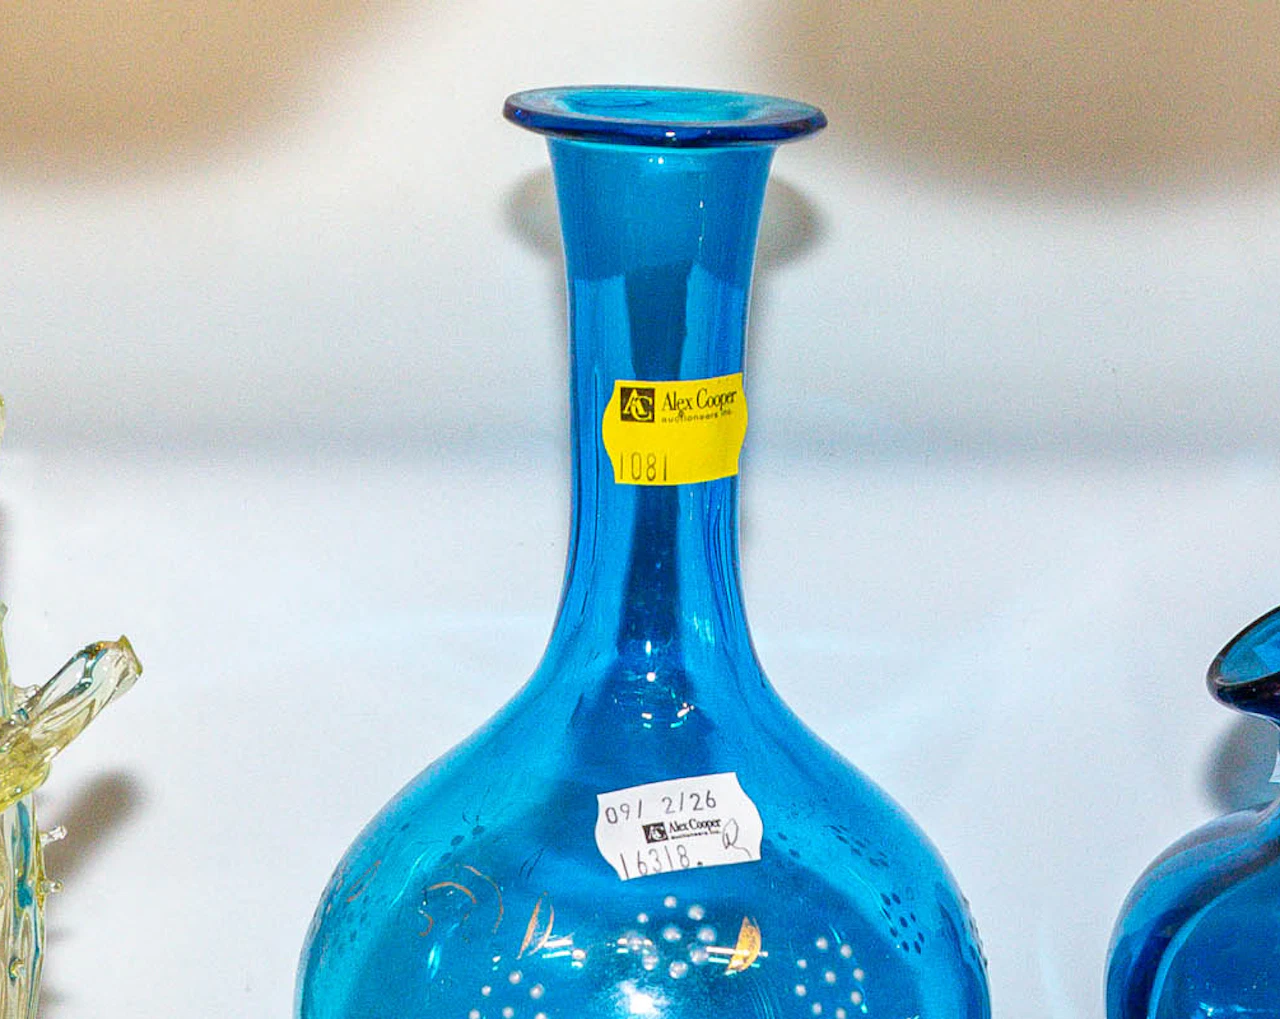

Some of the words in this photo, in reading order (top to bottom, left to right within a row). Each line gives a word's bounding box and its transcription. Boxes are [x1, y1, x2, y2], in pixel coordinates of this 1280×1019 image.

[662, 391, 694, 415] Alex
[696, 388, 738, 411] Cooper
[661, 411, 719, 423] auctioneers
[620, 452, 667, 482] 1081
[605, 799, 643, 825] 09/
[662, 789, 717, 815] 2/26
[669, 821, 689, 833] Alex
[689, 819, 722, 832] Cooper
